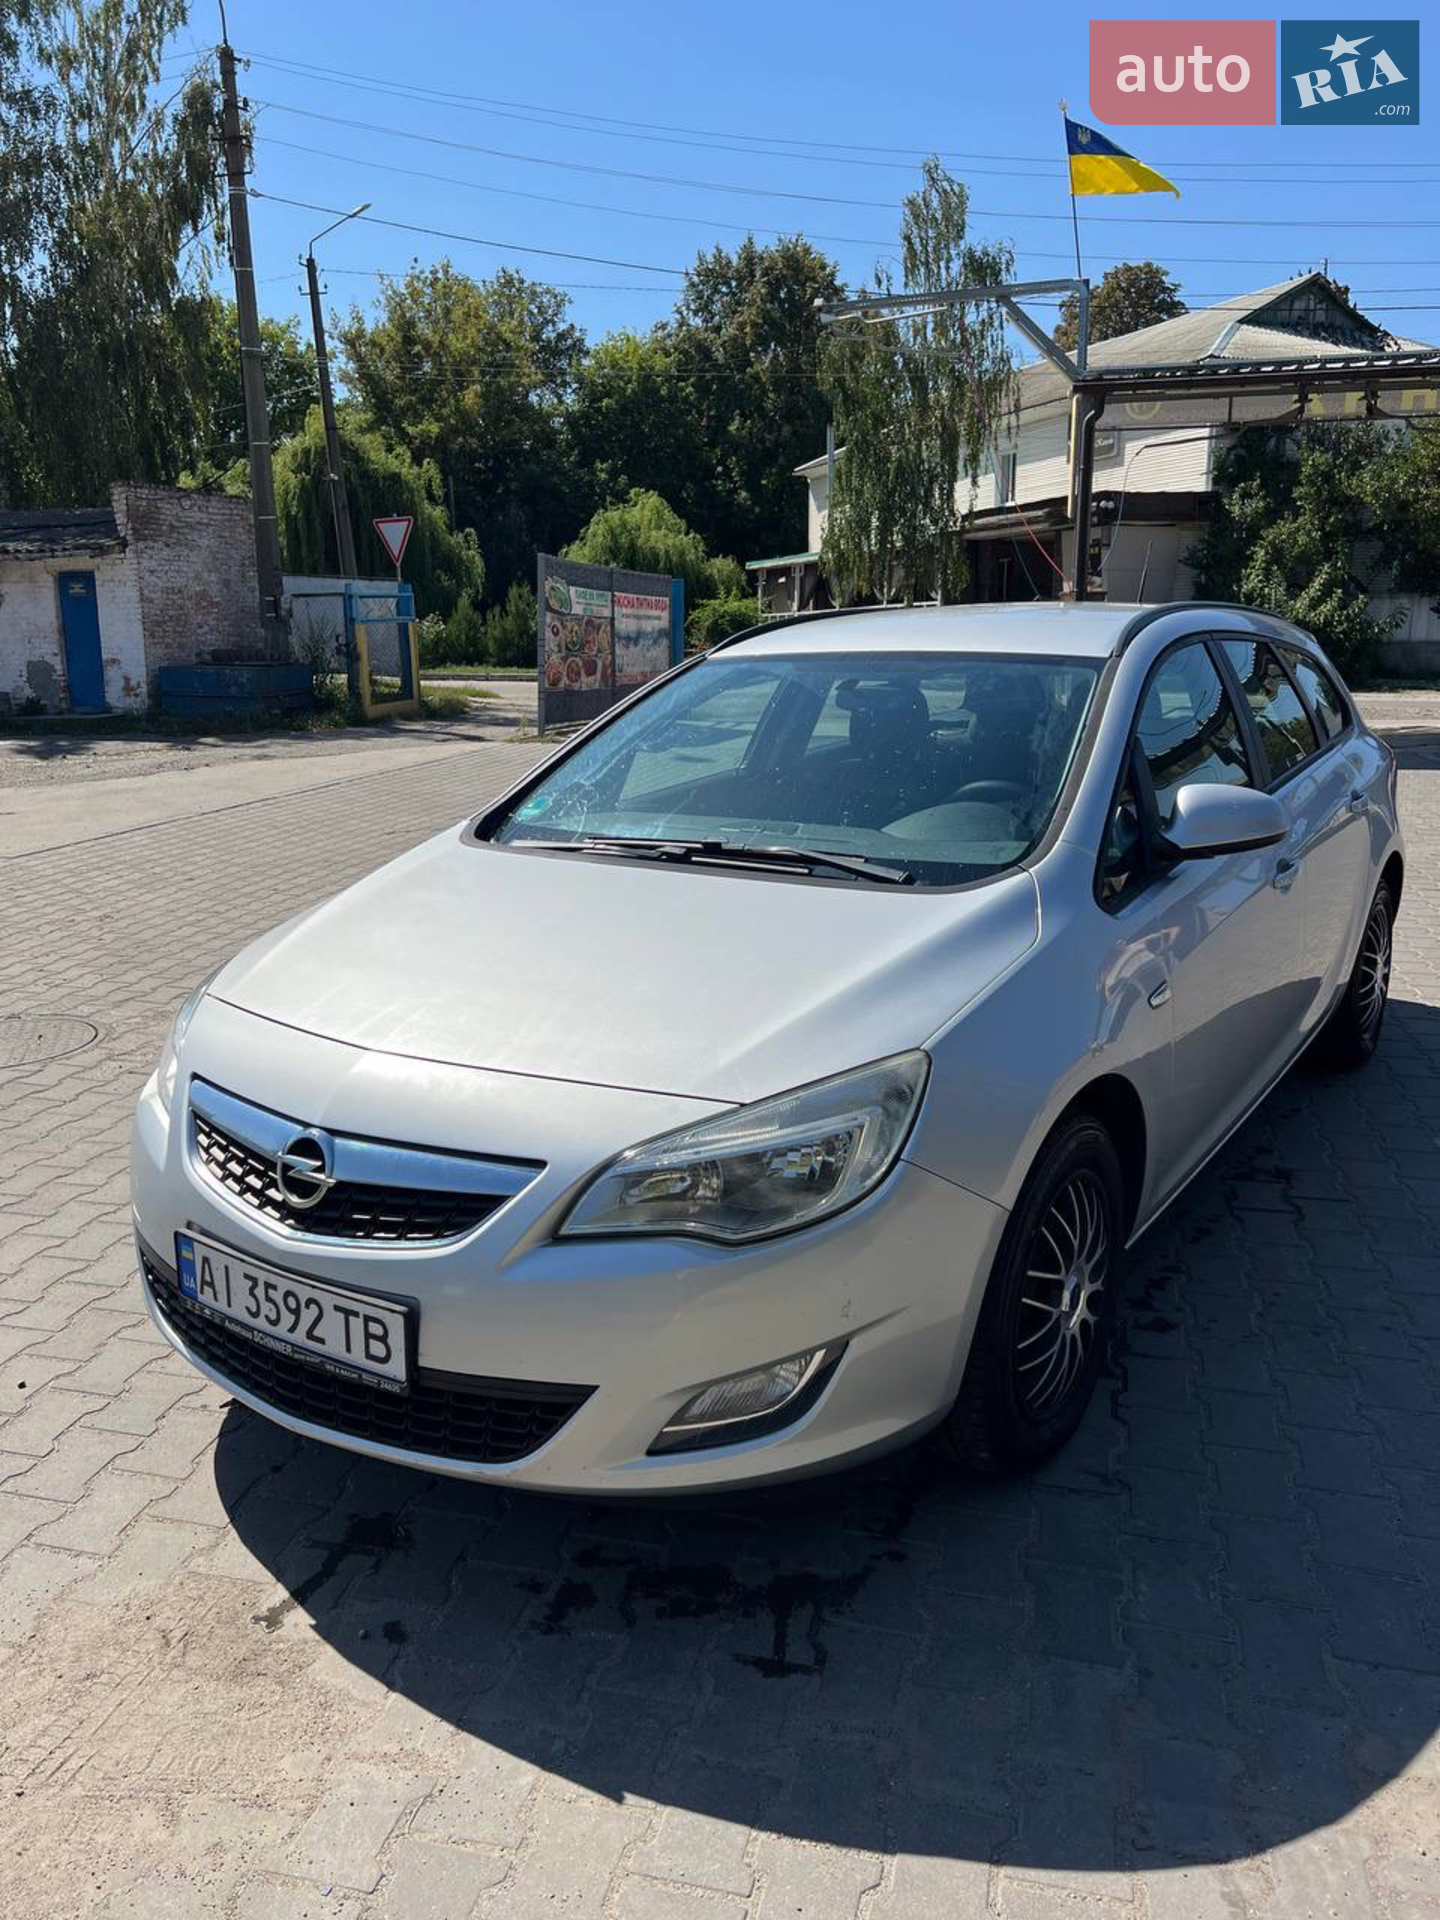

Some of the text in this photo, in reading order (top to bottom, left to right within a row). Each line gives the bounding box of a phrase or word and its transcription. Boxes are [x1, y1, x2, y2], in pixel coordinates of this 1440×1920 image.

[183, 1274, 196, 1290] UA
[243, 1272, 326, 1345] 3592
[333, 1304, 392, 1365] TB
